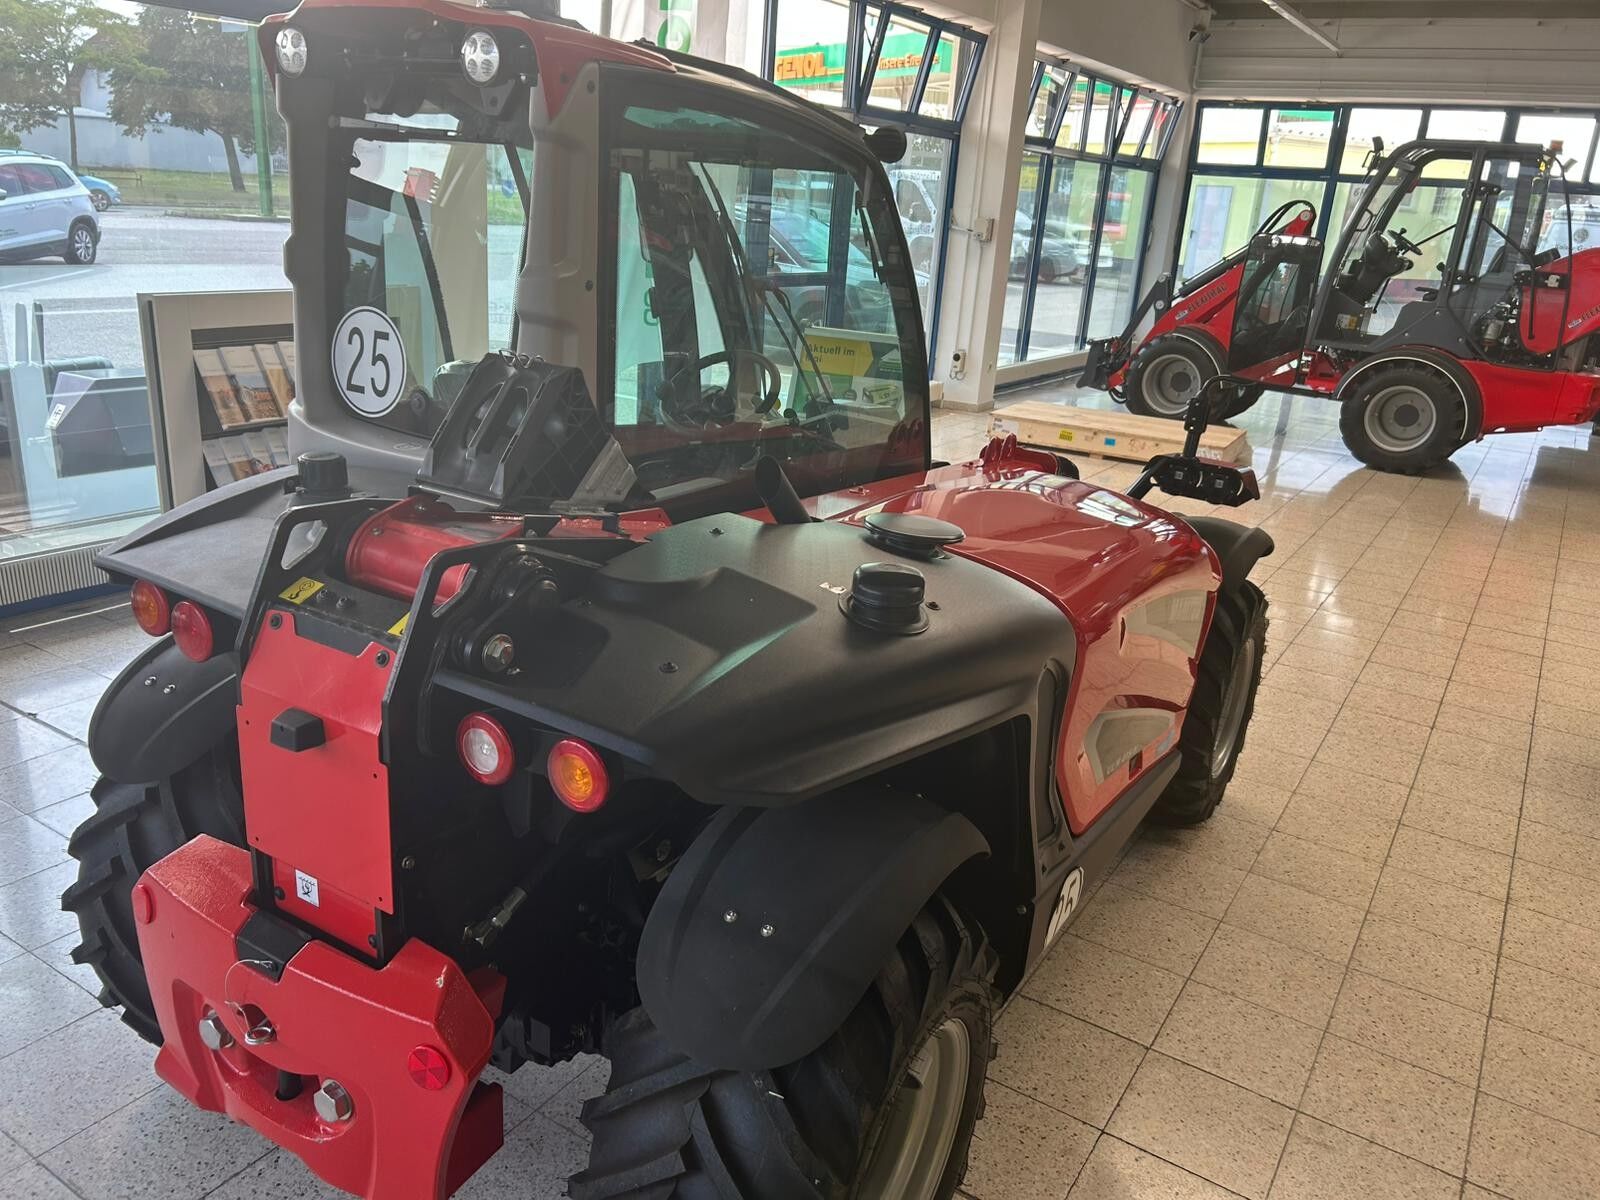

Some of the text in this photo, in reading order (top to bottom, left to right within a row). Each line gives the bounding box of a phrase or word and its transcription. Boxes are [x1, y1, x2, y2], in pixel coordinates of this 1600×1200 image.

[775, 52, 827, 80] GENOL
[346, 326, 391, 397] 25
[843, 347, 855, 356] im
